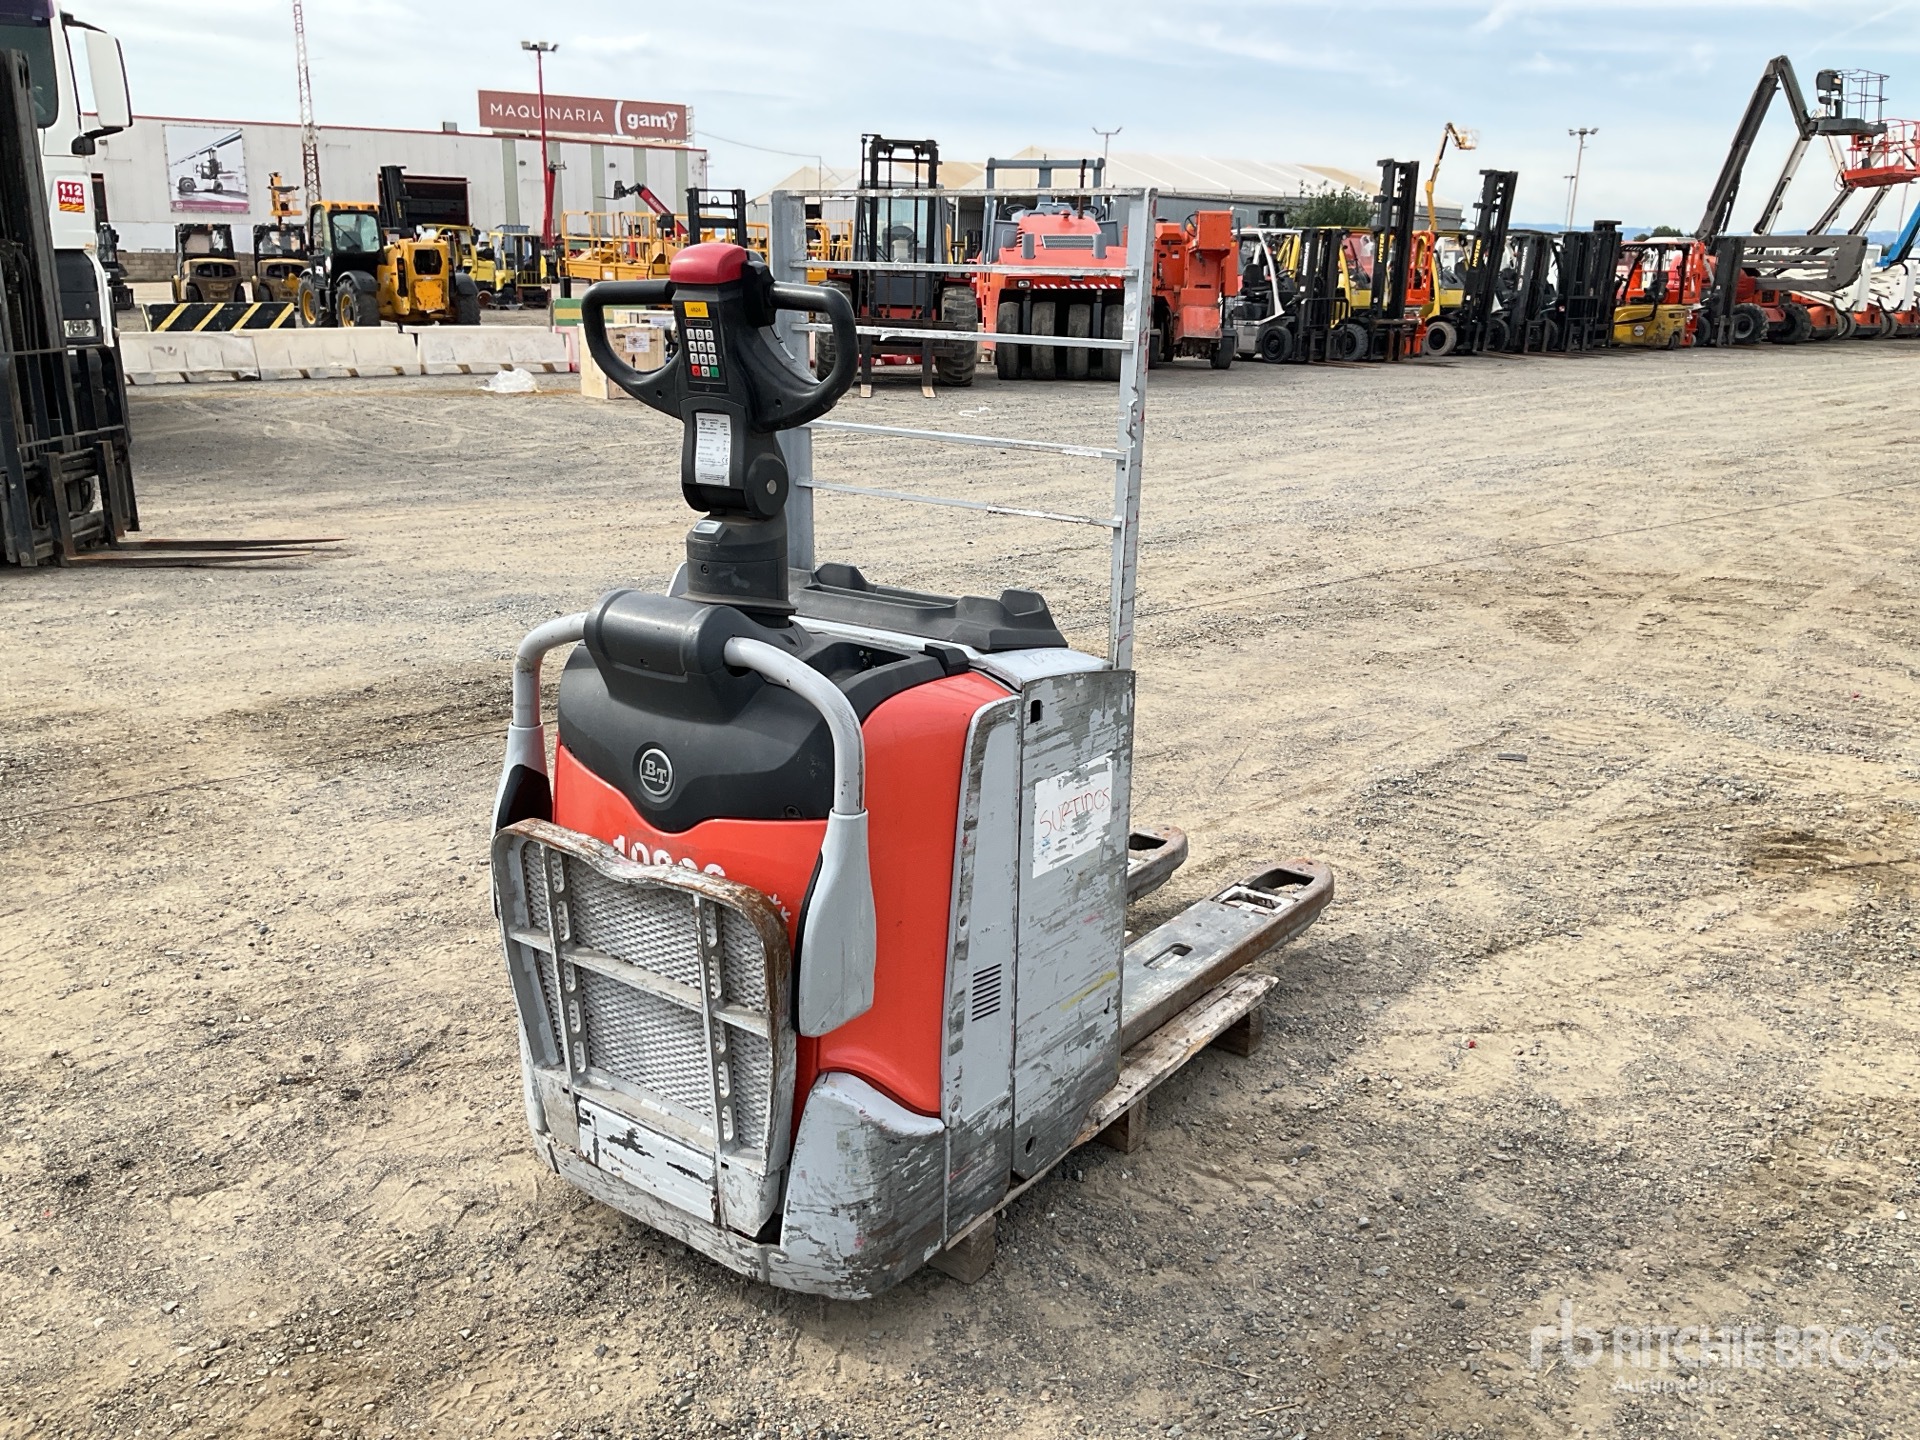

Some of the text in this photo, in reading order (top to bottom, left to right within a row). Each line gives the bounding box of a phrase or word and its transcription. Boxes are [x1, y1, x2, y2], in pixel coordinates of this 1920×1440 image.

[490, 102, 604, 123] MAQUINARIA
[59, 183, 83, 196] 112
[1377, 233, 1386, 263] HYSTER
[1471, 239, 1482, 268] HYSTER
[1039, 787, 1111, 839] SURTIDOS
